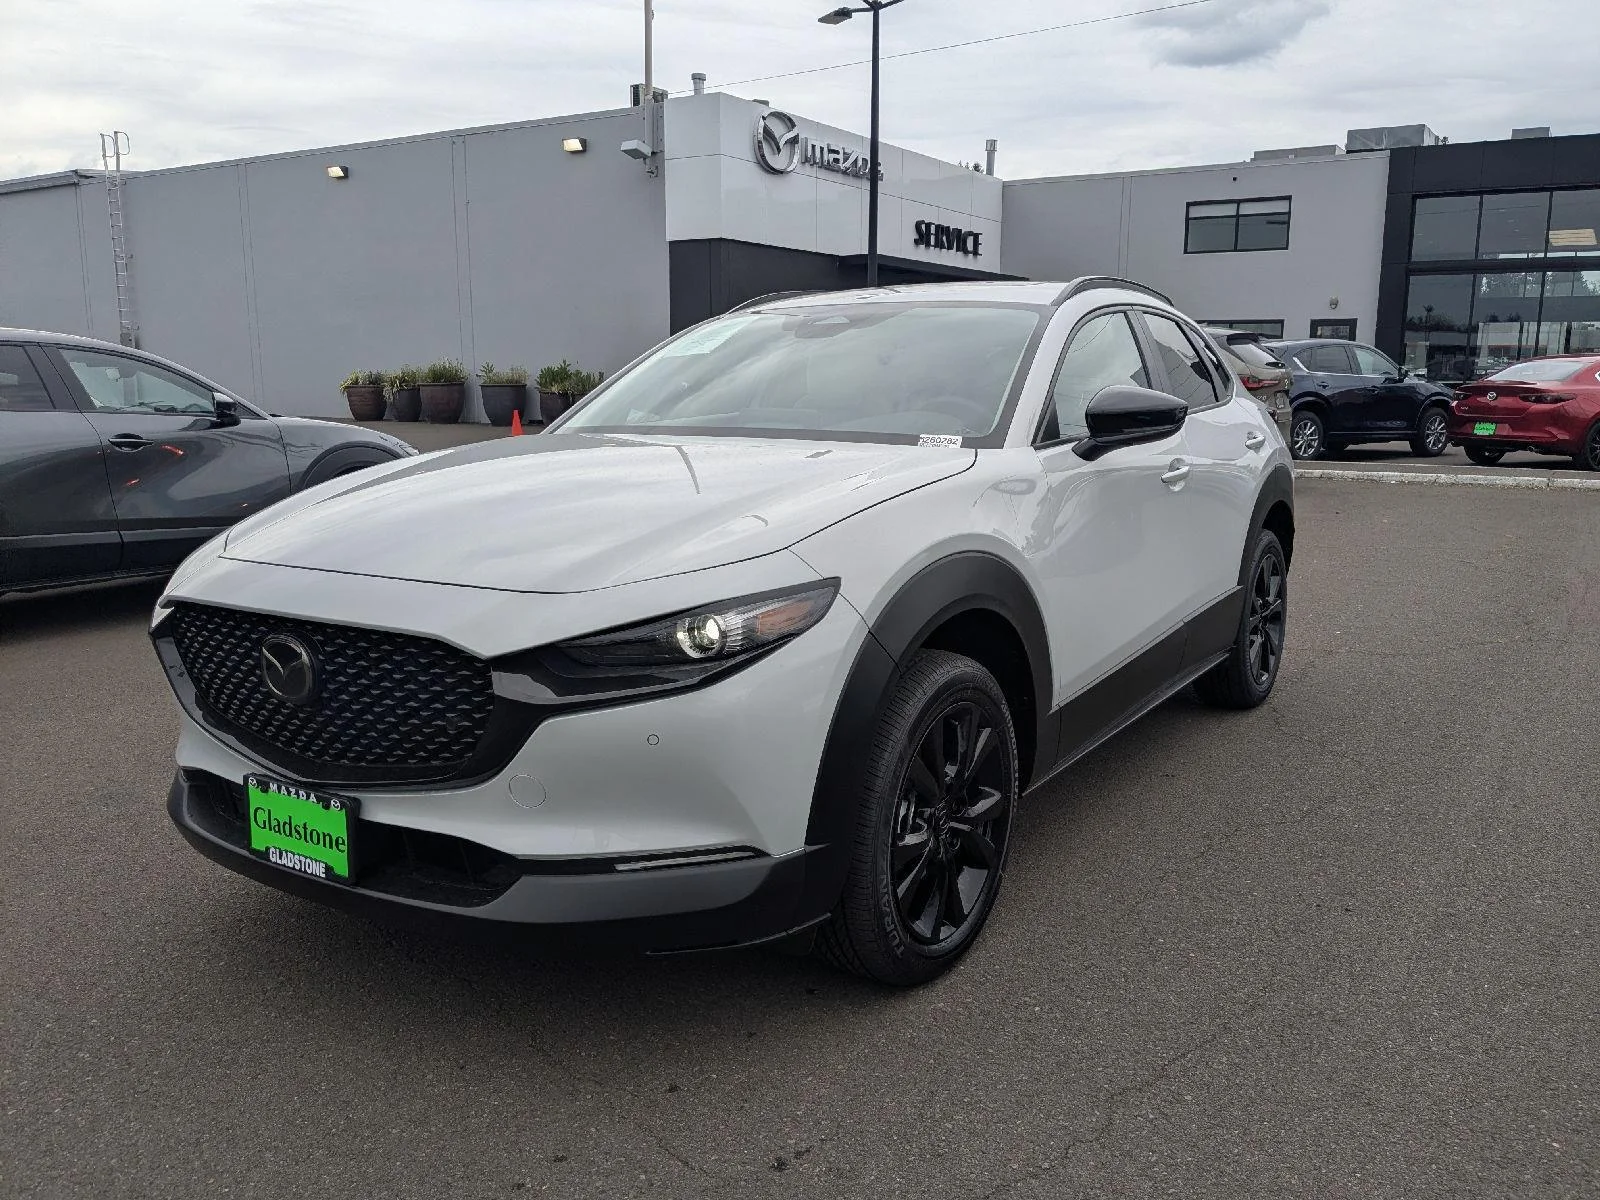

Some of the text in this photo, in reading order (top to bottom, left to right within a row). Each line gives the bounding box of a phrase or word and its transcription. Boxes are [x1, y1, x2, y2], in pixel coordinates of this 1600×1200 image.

[913, 219, 983, 257] SERVICE
[269, 782, 317, 803] MAZDA
[253, 806, 346, 853] Gladstone
[269, 847, 326, 878] GLADSTONE
